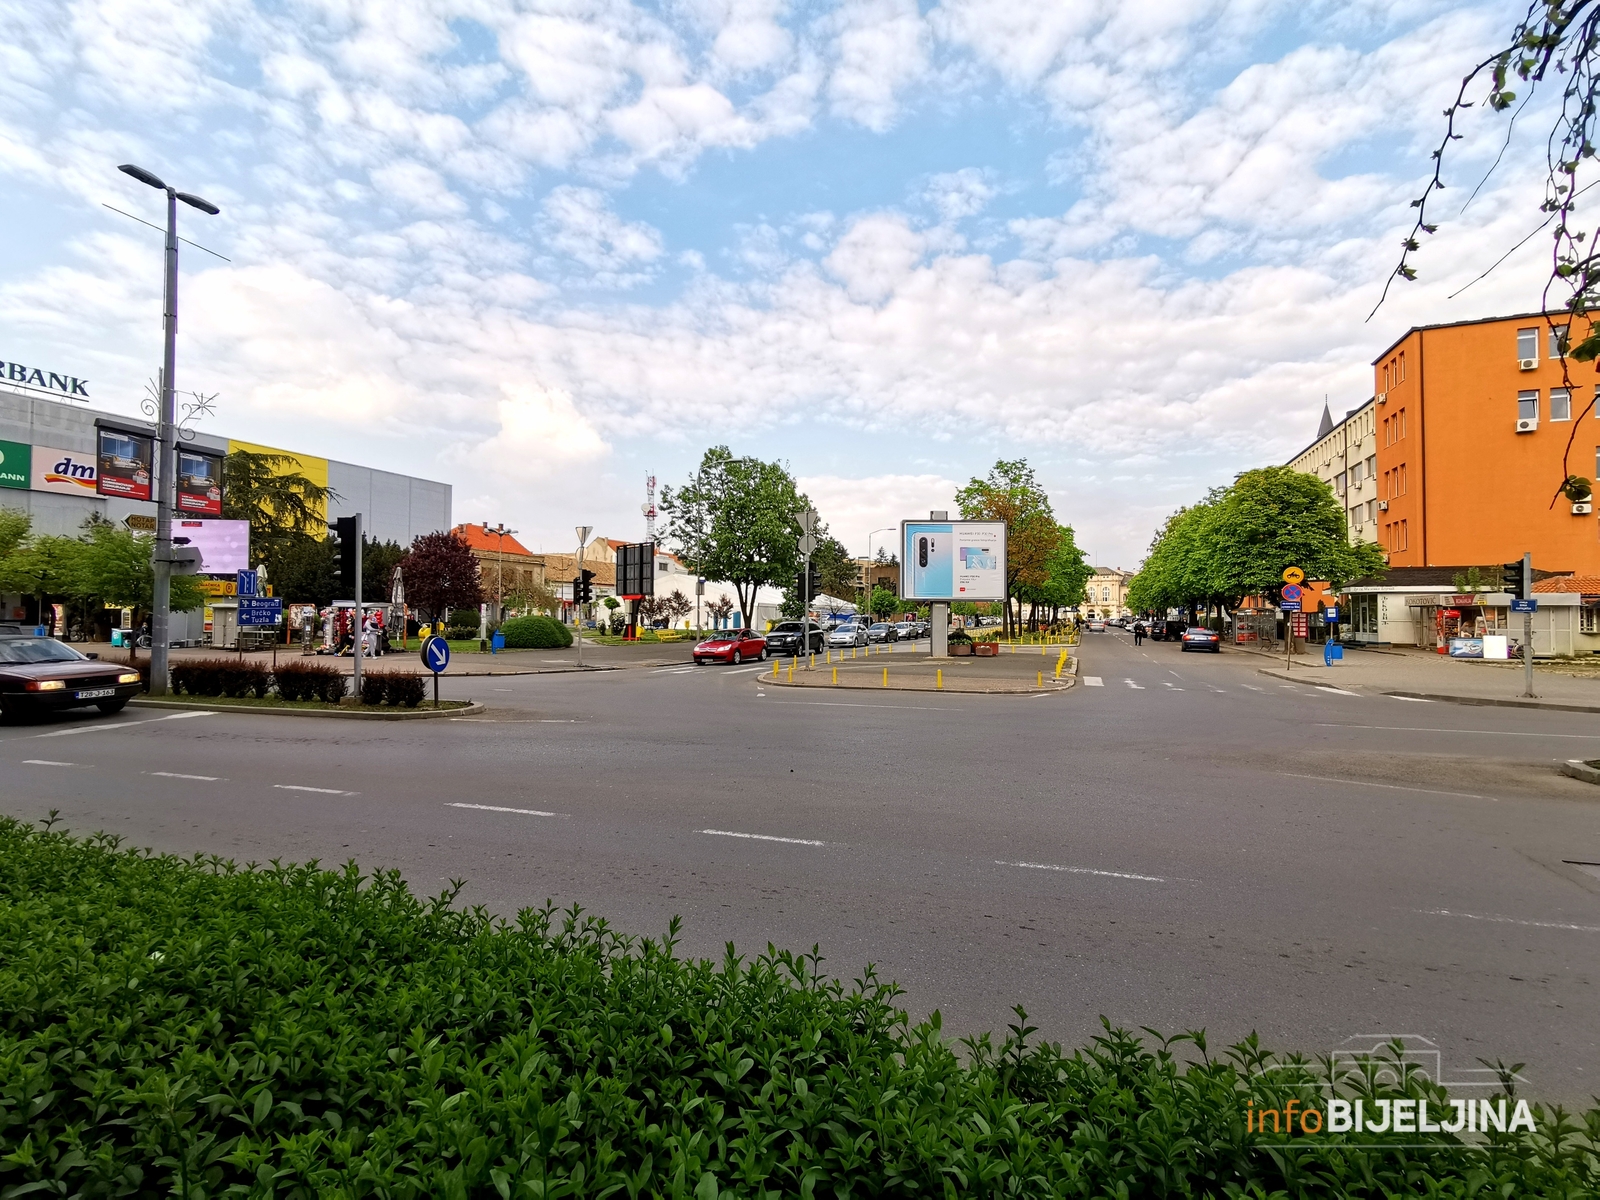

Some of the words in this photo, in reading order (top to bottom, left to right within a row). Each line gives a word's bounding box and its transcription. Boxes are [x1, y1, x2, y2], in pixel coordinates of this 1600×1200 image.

[53, 457, 95, 479] dm
[131, 522, 155, 530] NOTAR
[251, 600, 279, 609] Beograd
